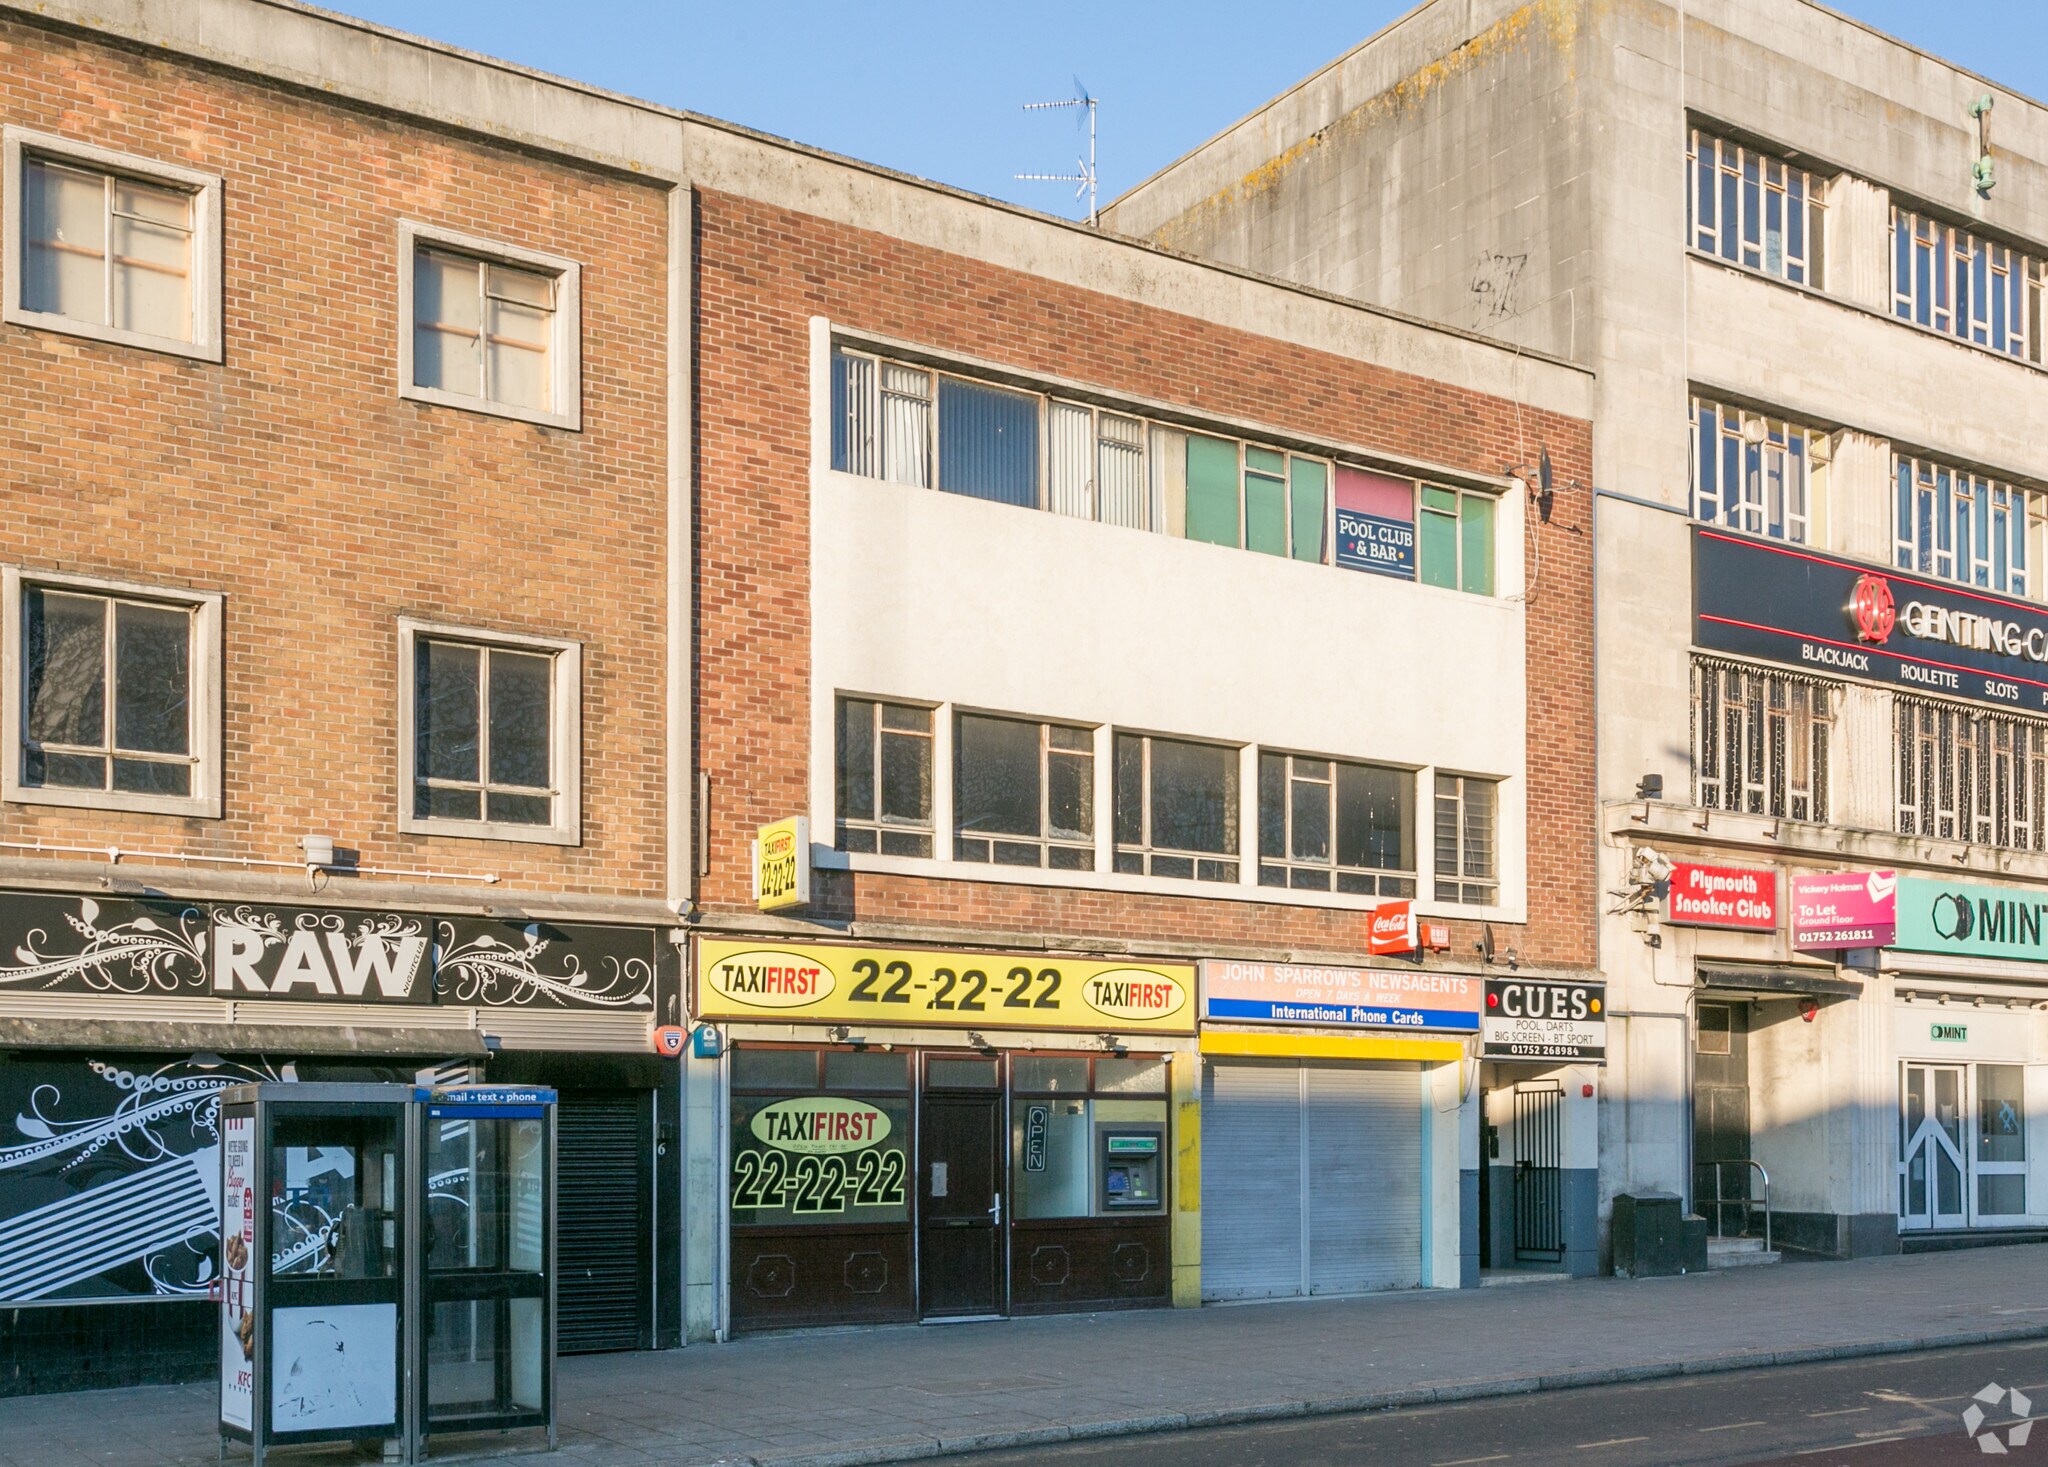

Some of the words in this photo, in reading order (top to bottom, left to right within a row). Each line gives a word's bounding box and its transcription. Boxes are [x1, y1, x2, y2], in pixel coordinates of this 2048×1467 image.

[1340, 519, 1376, 540] POOL
[1378, 527, 1413, 547] CLUB
[1356, 540, 1367, 556] &
[1369, 543, 1398, 561] BAR
[1902, 601, 2022, 656] GENTING
[1802, 644, 1869, 672] BLACKJACK
[1901, 664, 1959, 689] ROULETTE
[1985, 680, 2019, 700] SLOTS
[764, 836, 791, 856] TAXIFIRST
[1690, 869, 1757, 895] Plymouth
[1799, 885, 1829, 894] Vickery
[1830, 883, 1864, 892] Holman
[1676, 893, 1734, 916] Snooker
[1736, 898, 1772, 920] Club
[1799, 905, 1814, 916] To
[1816, 904, 1837, 915] Let
[1799, 917, 1830, 925] Ground
[1799, 931, 1833, 942] 01752
[1834, 930, 1874, 940] 261811
[215, 926, 428, 997] RAW
[403, 940, 424, 994] NIGHTCLUB
[722, 965, 820, 995] TAXIFIRST
[848, 958, 1062, 1012] 22-22-22
[1093, 981, 1173, 1009] TAXIFIRST
[1223, 964, 1265, 981] JOHN
[1274, 967, 1361, 988] SPARROW'S
[1369, 973, 1468, 994] NEWSAGENTS
[1296, 988, 1323, 999] OPEN
[1326, 990, 1333, 999] 7
[1336, 991, 1360, 1000] DAYS
[1364, 992, 1370, 1001] A
[1376, 994, 1402, 1003] WEEK
[1502, 985, 1588, 1020] CUES
[1271, 1004, 1346, 1021] International
[1351, 1007, 1387, 1023] Phone
[1392, 1011, 1424, 1025] Cards
[1495, 1031, 1509, 1041] BIG
[1512, 1033, 1545, 1043] SCREEN
[1553, 1034, 1564, 1043] BT
[1567, 1034, 1594, 1044] SPORT
[1546, 1022, 1574, 1032] DARTS
[1944, 1027, 1967, 1039] MINT
[1511, 1045, 1540, 1054] 01752
[1543, 1046, 1579, 1056] 268984
[477, 1093, 497, 1101] text
[506, 1092, 537, 1102] phone
[765, 1112, 878, 1141] TAXIFIRST
[657, 1142, 666, 1155] 6
[1030, 1109, 1045, 1168] OPEN
[732, 1149, 906, 1214] 22-22-22
[238, 1370, 251, 1388] KFC
